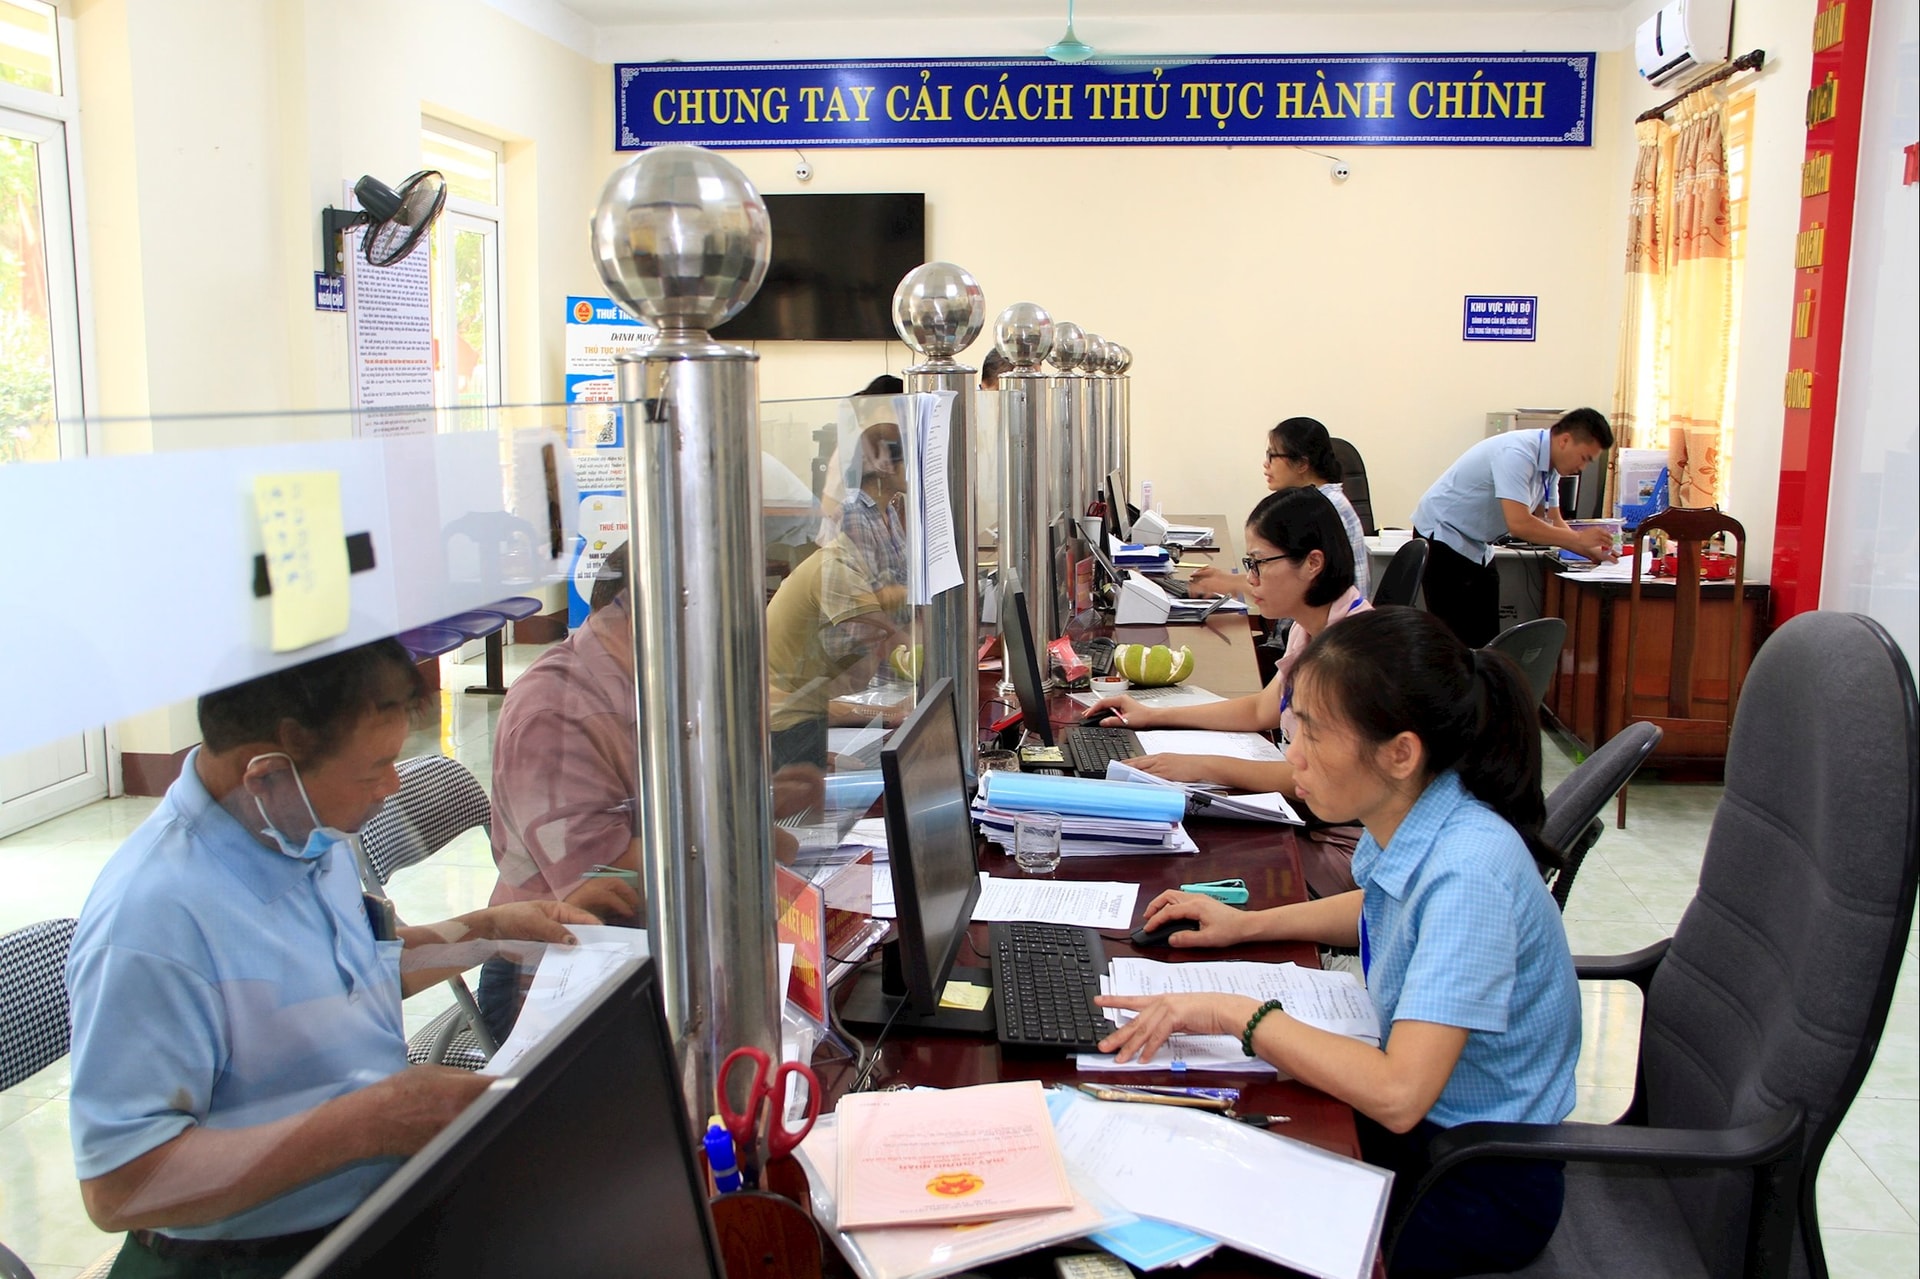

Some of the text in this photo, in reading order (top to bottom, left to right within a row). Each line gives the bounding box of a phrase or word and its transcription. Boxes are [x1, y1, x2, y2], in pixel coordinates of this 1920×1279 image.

[653, 67, 1546, 130] CHUNG TAY CẢI CÁCH THỦ TỤC HÀNH CHÍNH
[596, 306, 618, 320] THUẾ
[1470, 301, 1531, 315] KHU VỰC NỘI BỘ
[610, 332, 635, 342] DANH
[584, 345, 598, 354] THỦ
